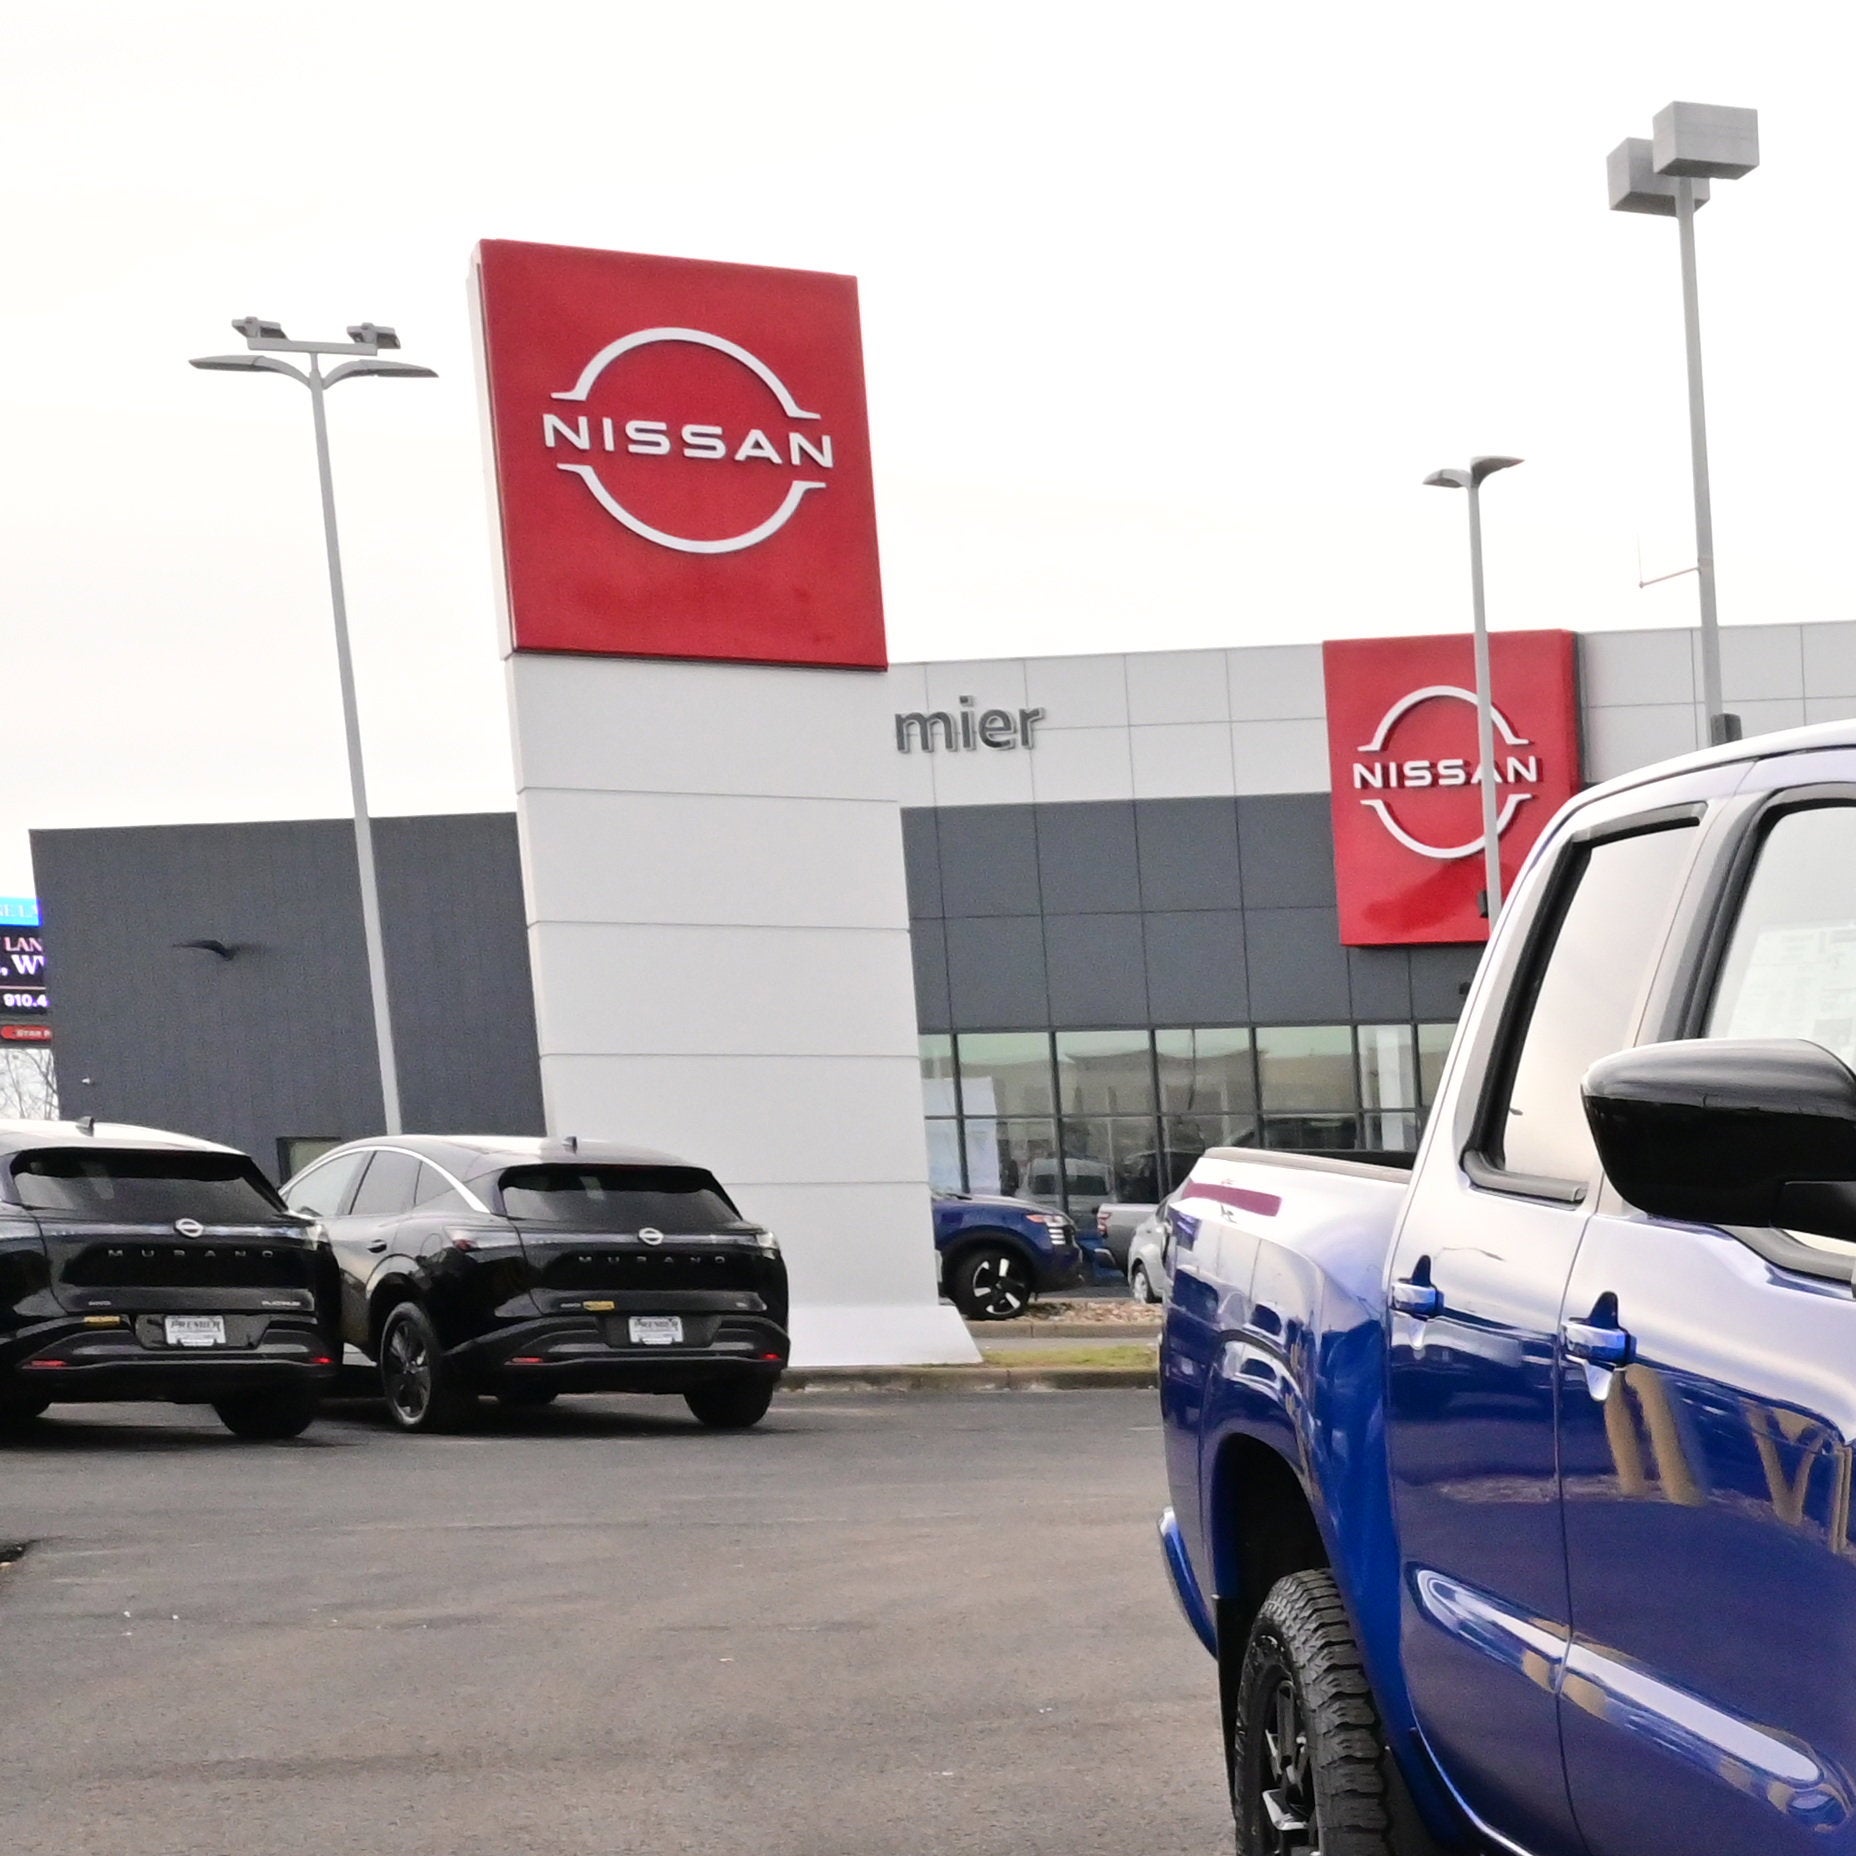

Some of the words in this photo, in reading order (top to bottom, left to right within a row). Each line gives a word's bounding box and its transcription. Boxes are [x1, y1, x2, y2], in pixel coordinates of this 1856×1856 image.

[543, 412, 835, 469] NISSAN
[894, 695, 1045, 753] mier
[107, 1249, 274, 1257] MURANO
[578, 1255, 726, 1264] MURANO
[170, 1319, 223, 1332] PREMIER
